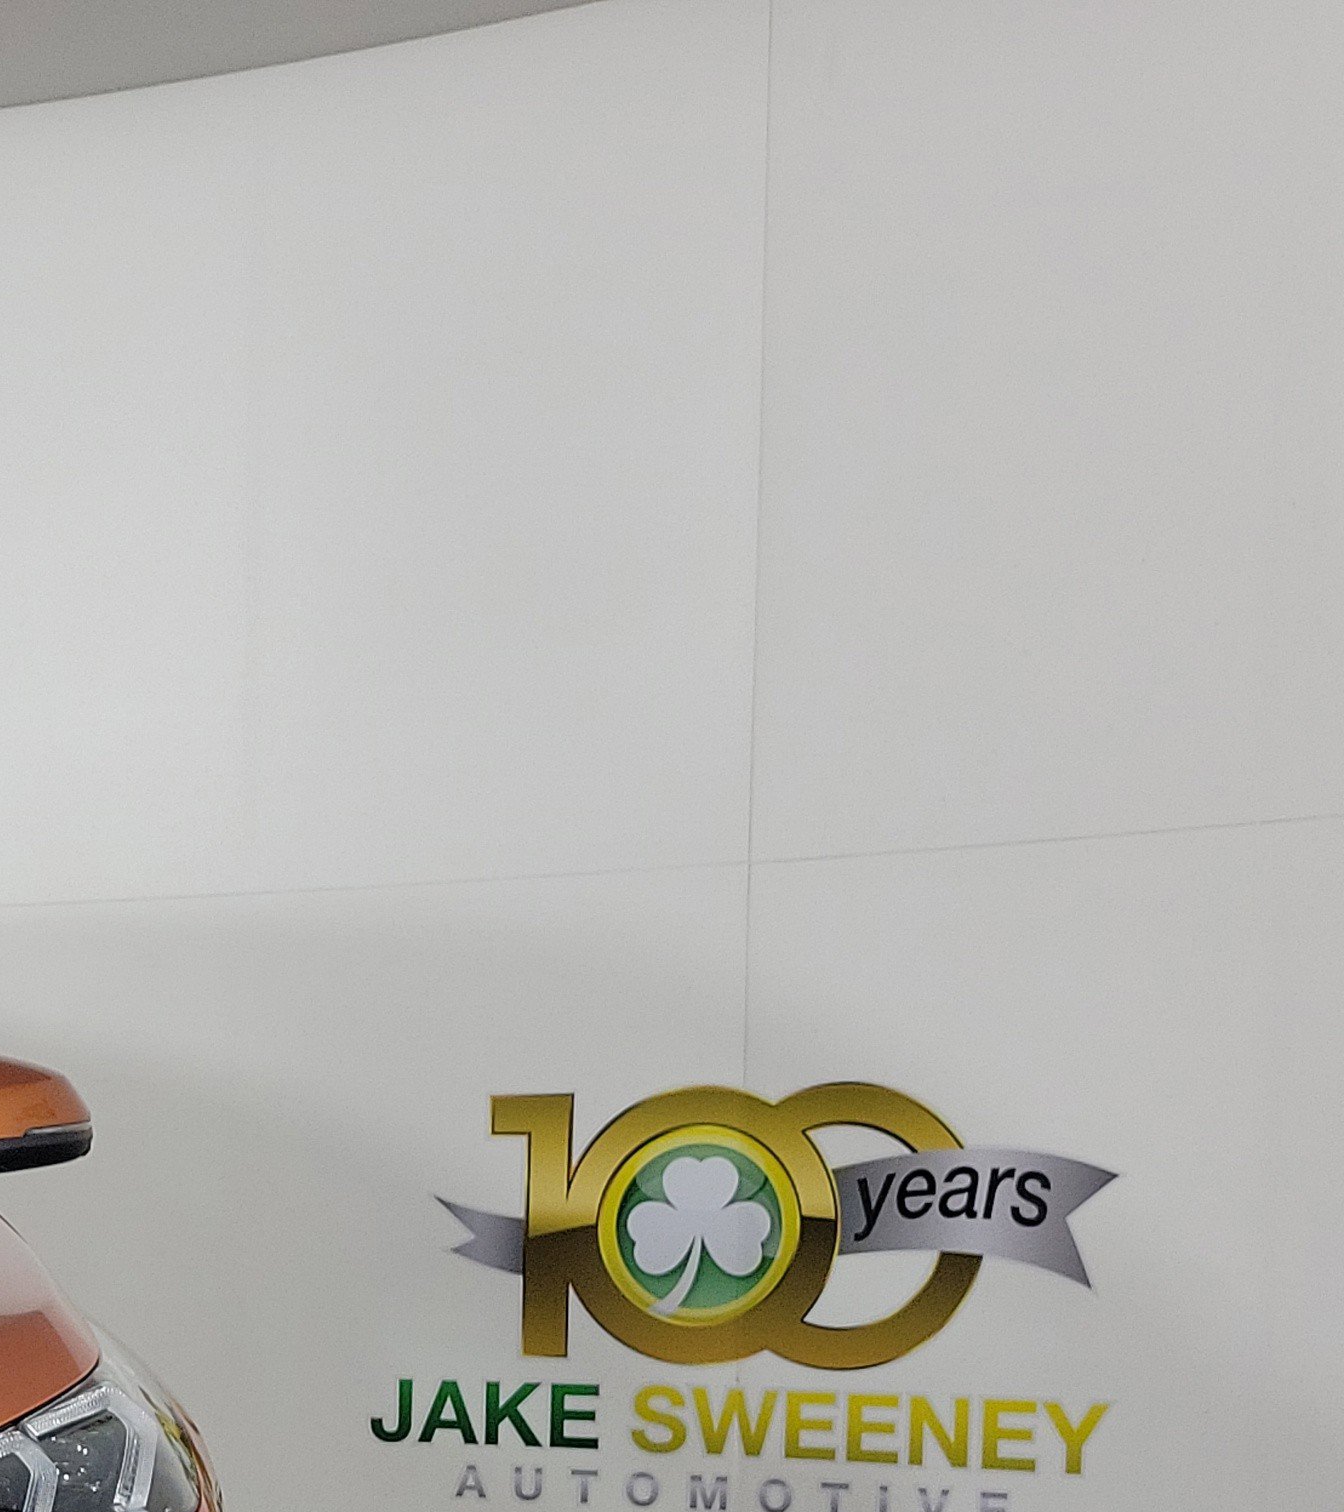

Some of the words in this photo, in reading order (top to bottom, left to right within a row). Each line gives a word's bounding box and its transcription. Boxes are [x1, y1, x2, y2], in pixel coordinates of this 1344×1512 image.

[491, 1081, 984, 1370] 100
[853, 1163, 1052, 1242] years
[370, 1379, 600, 1449] JAKE
[630, 1384, 1110, 1475] SWEENEY
